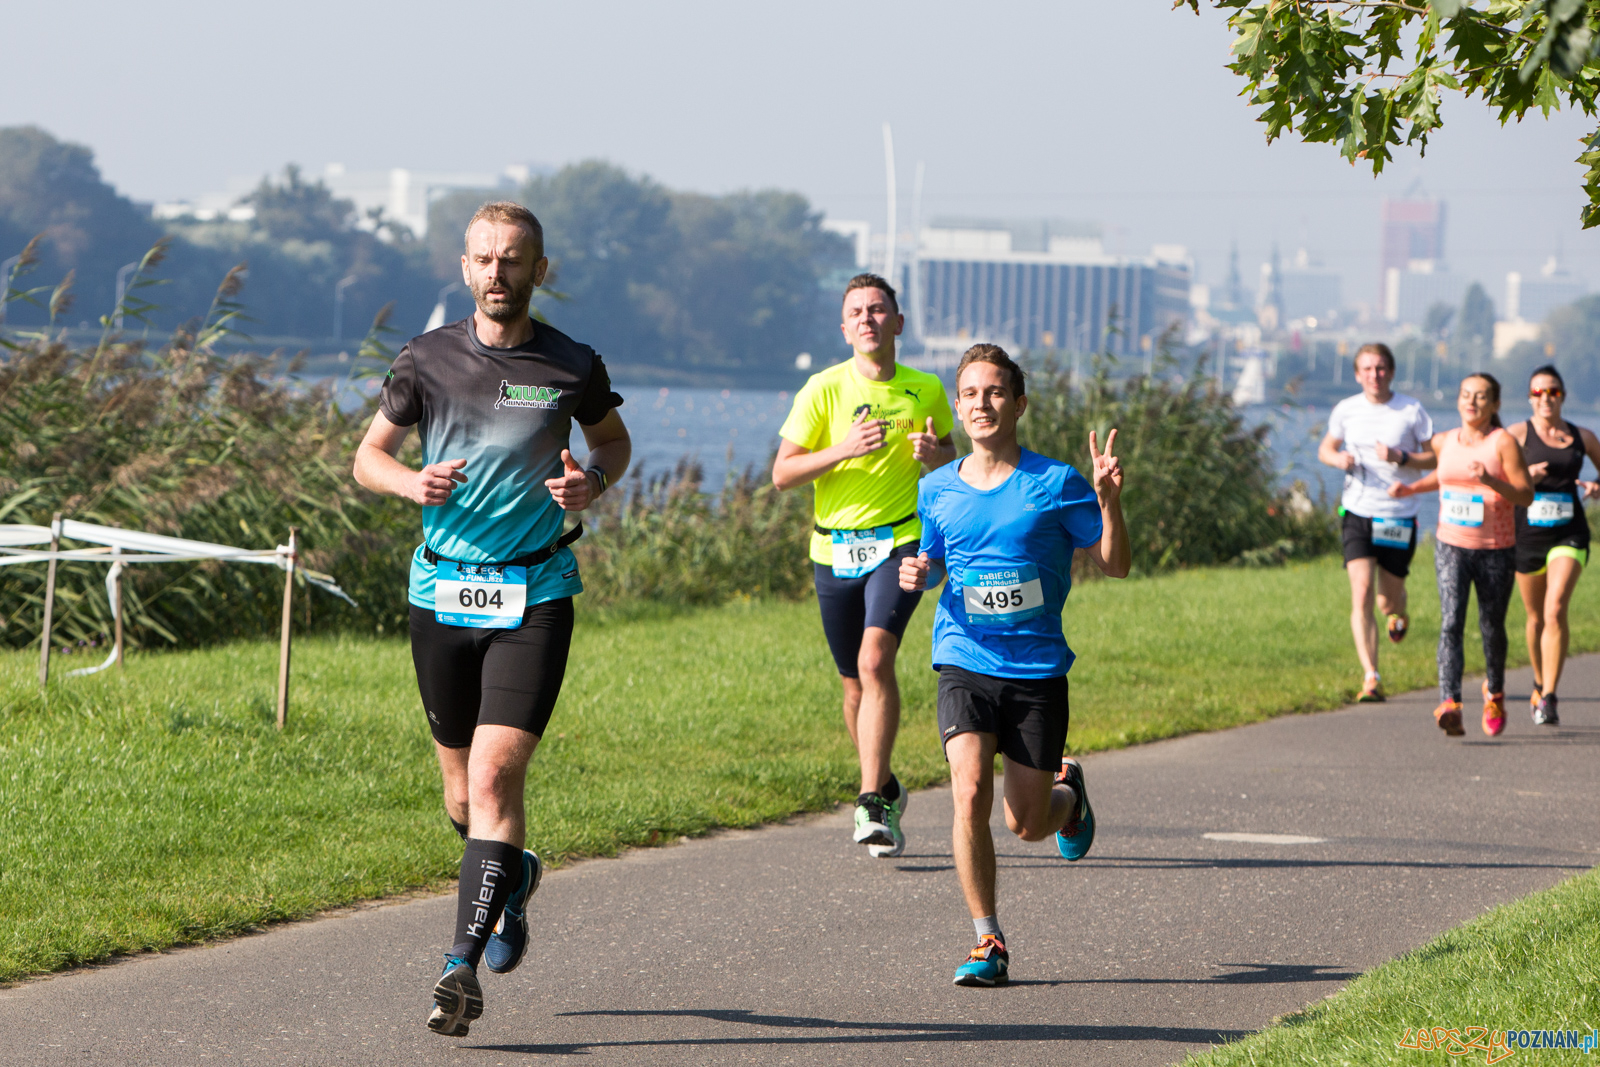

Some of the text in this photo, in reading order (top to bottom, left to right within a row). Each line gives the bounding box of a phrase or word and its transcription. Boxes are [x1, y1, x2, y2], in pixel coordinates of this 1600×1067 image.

[506, 386, 562, 402] MUAY
[505, 400, 558, 409] RUNNING TEAM
[896, 418, 914, 430] RUN
[1451, 505, 1470, 517] 491
[848, 546, 877, 563] 163
[979, 570, 1019, 580] zaBIEGaj
[459, 588, 503, 609] 604
[983, 589, 1023, 609] 495
